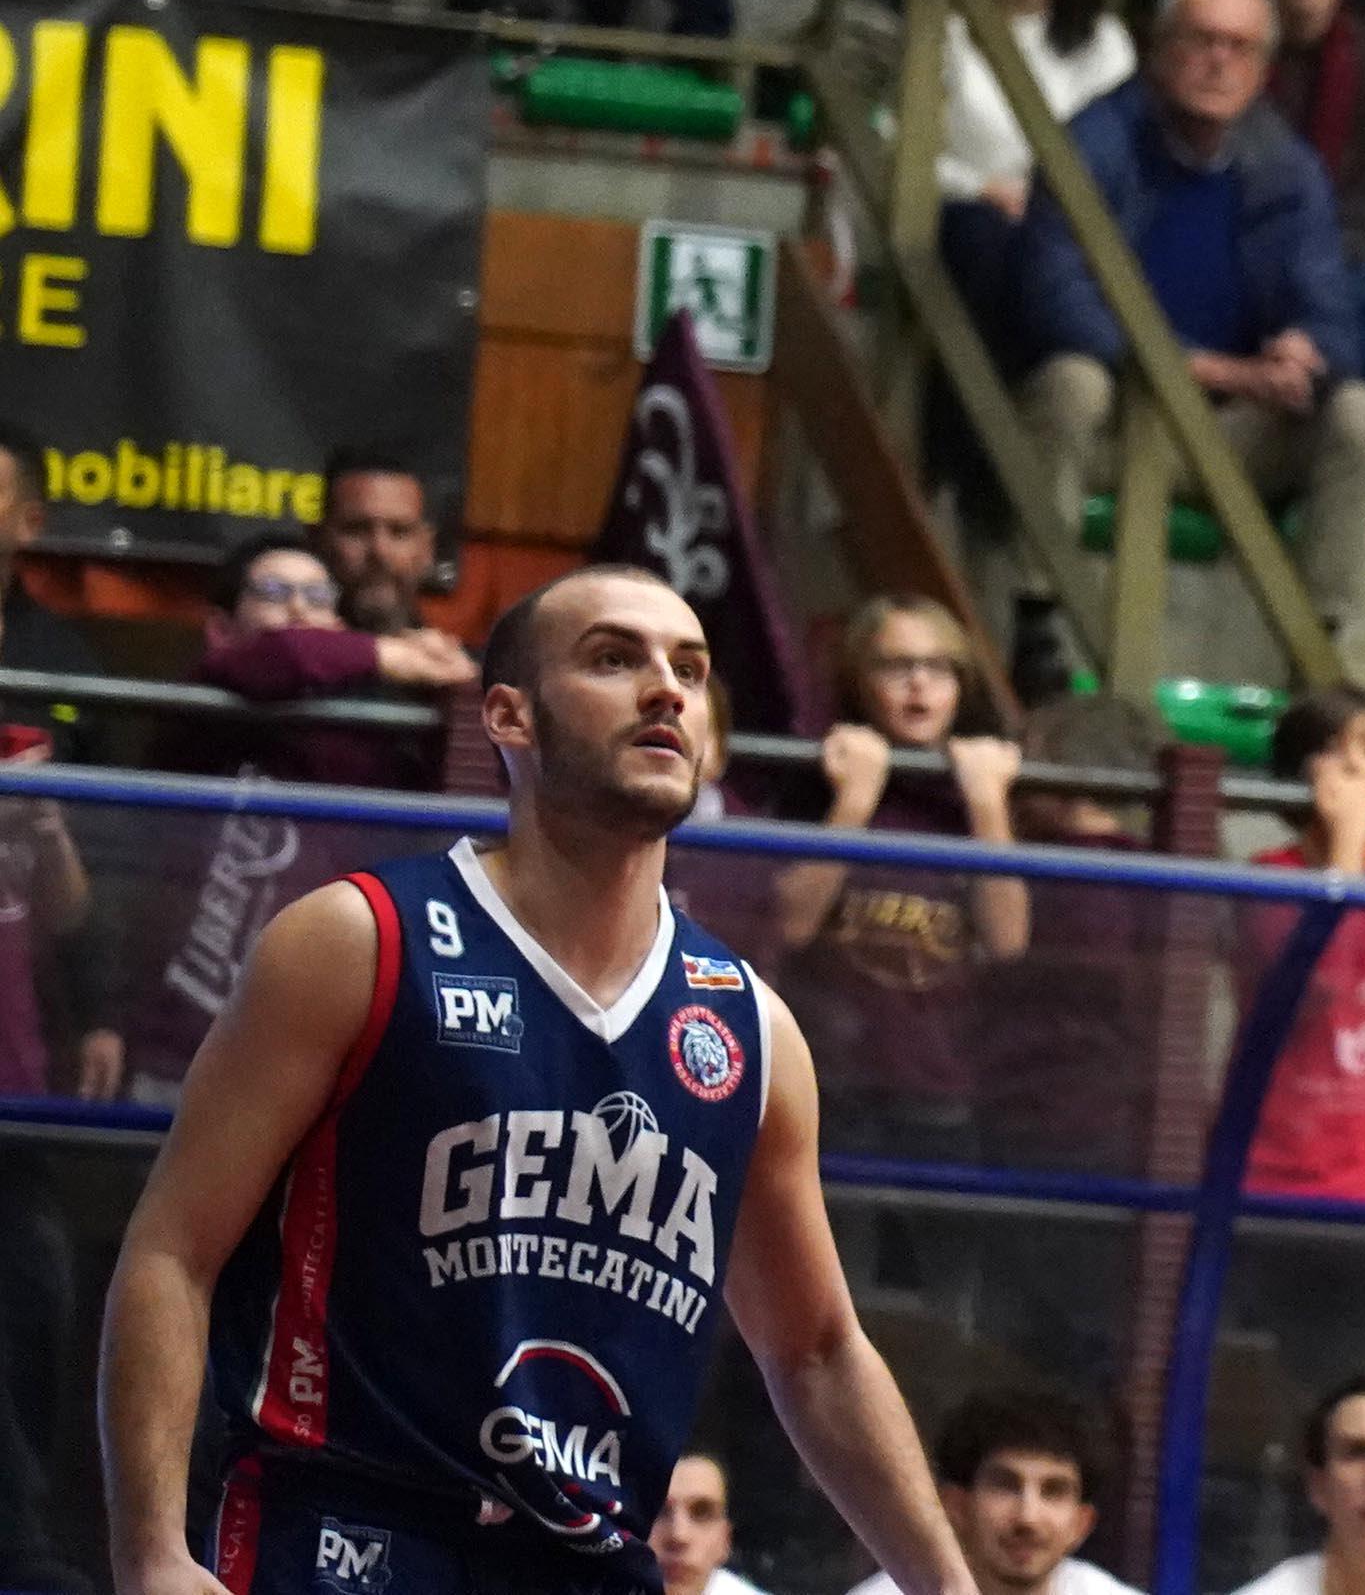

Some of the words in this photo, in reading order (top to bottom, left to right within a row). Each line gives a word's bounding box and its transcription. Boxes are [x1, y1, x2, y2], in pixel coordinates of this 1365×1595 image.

[0, 14, 326, 256] INI
[426, 898, 465, 957] 9
[440, 987, 514, 1037] PM
[419, 1109, 718, 1287] GEMA
[422, 1233, 708, 1335] MONTECATINI
[289, 1334, 326, 1406] PM
[315, 1527, 384, 1584] PM
